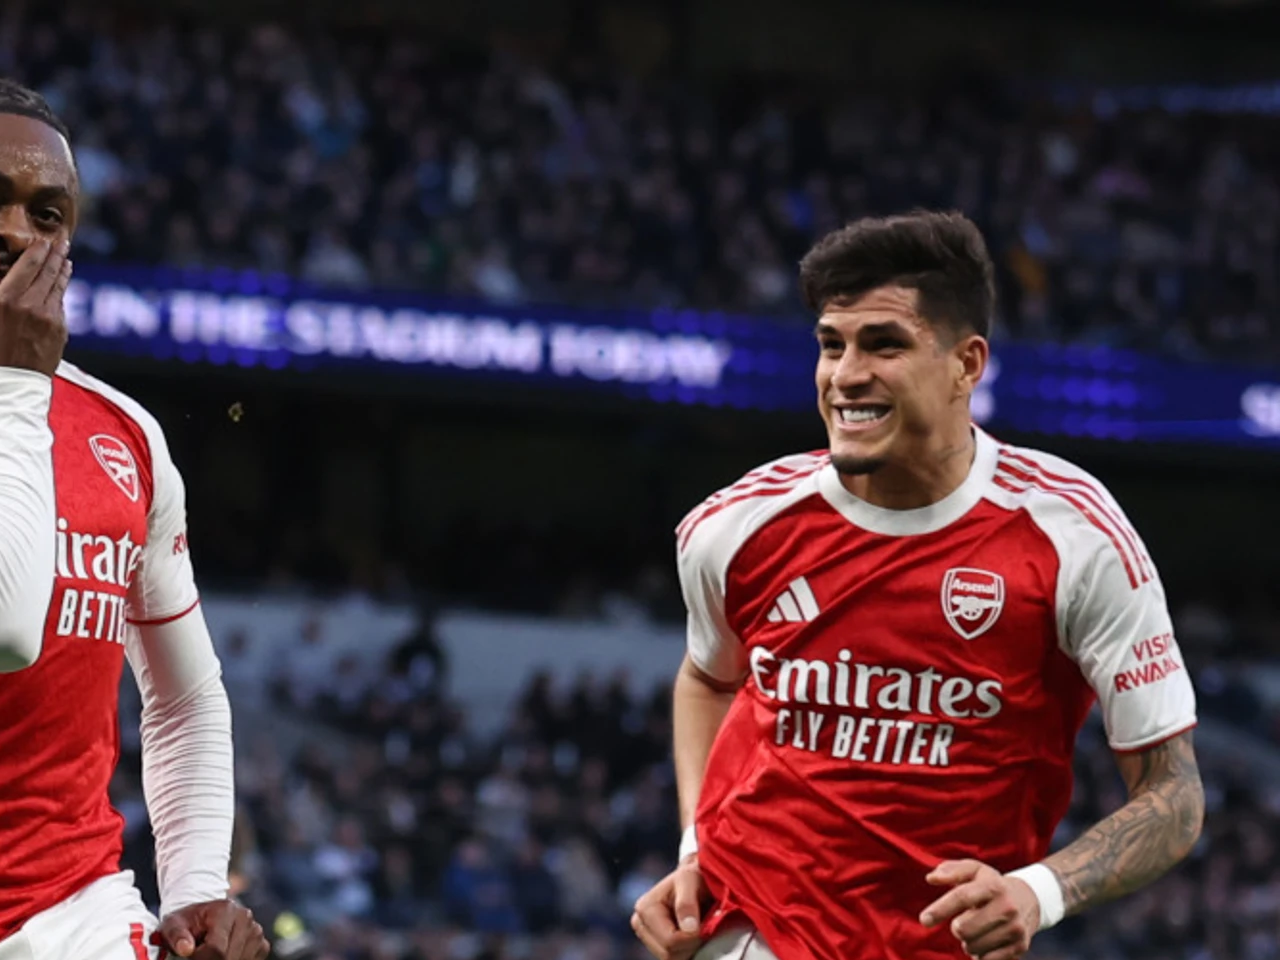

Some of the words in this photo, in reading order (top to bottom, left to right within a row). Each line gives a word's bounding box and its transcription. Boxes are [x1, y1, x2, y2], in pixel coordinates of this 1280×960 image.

[92, 283, 162, 338] IN
[167, 290, 287, 350] THE
[285, 301, 542, 373] STADIUM
[546, 322, 732, 388] TODAY
[951, 578, 996, 594] Arsenal
[750, 646, 1003, 719] Emirates
[776, 709, 824, 751] FLY
[832, 714, 954, 766] BETTER
